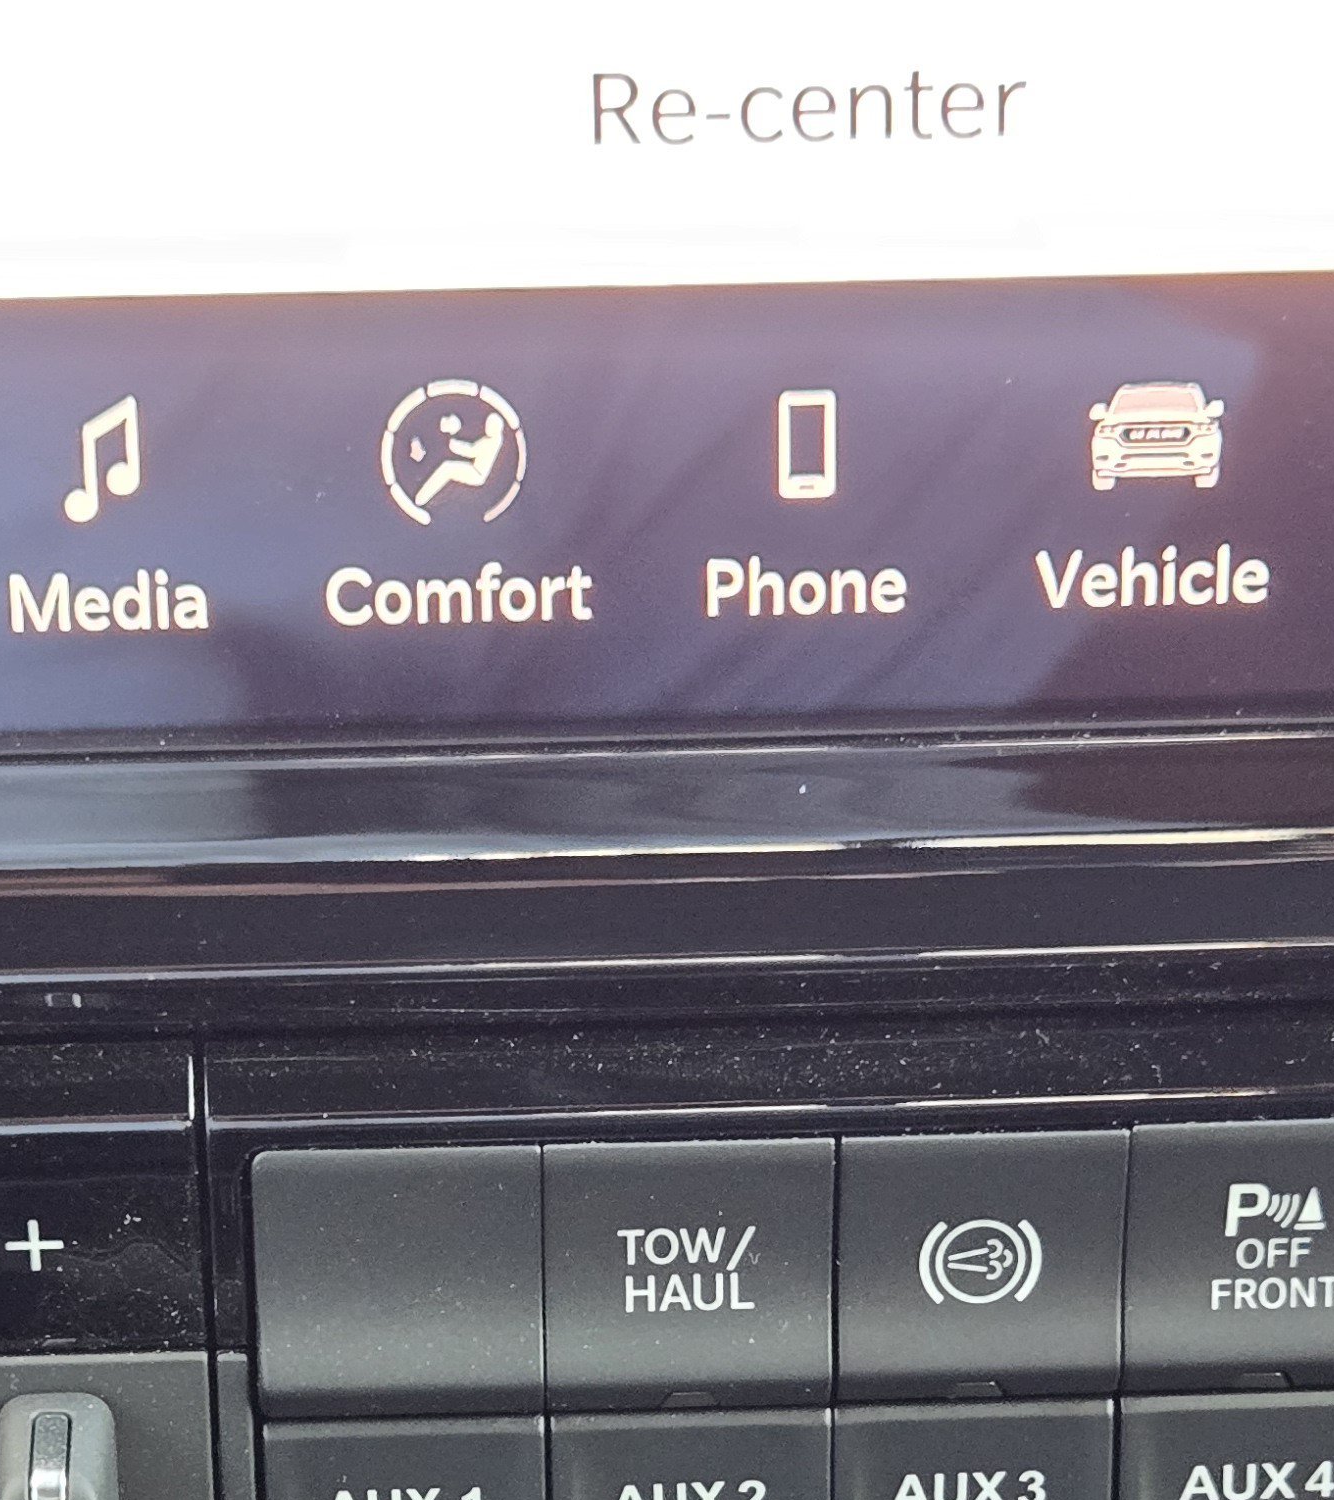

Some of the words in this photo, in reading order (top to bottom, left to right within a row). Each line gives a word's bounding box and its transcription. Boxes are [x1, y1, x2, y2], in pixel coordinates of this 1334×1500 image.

[592, 70, 1027, 145] Re-center
[8, 568, 209, 633] Media
[325, 561, 593, 626] Comfort
[706, 555, 907, 618] Phone
[1035, 543, 1270, 609] Vehicle
[616, 1225, 756, 1271] TOW/
[1235, 1236, 1313, 1270] OFF
[625, 1272, 756, 1313] HAUL
